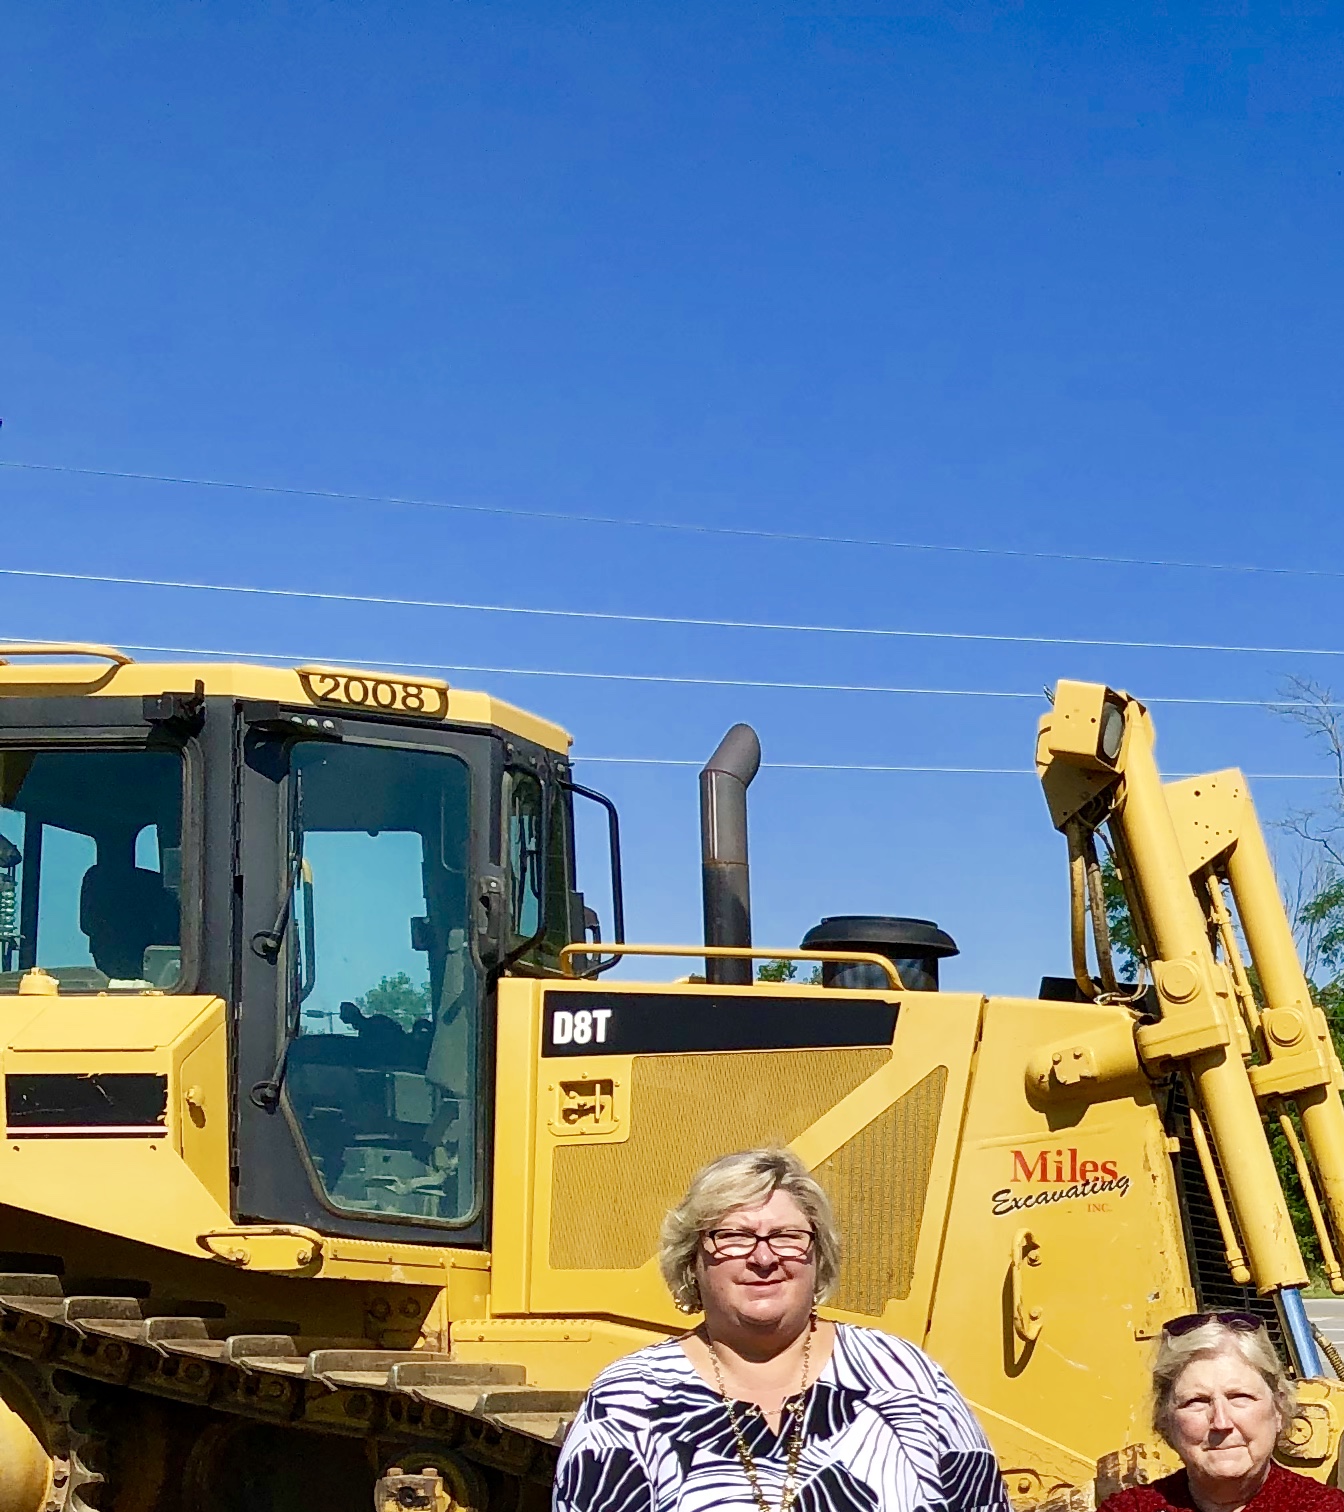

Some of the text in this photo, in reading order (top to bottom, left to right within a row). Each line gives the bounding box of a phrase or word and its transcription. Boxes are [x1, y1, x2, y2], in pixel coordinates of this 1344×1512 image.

[318, 674, 425, 712] 2008
[552, 1008, 612, 1045] D8T
[1009, 1147, 1119, 1183] Miles
[991, 1175, 1130, 1216] Excavating
